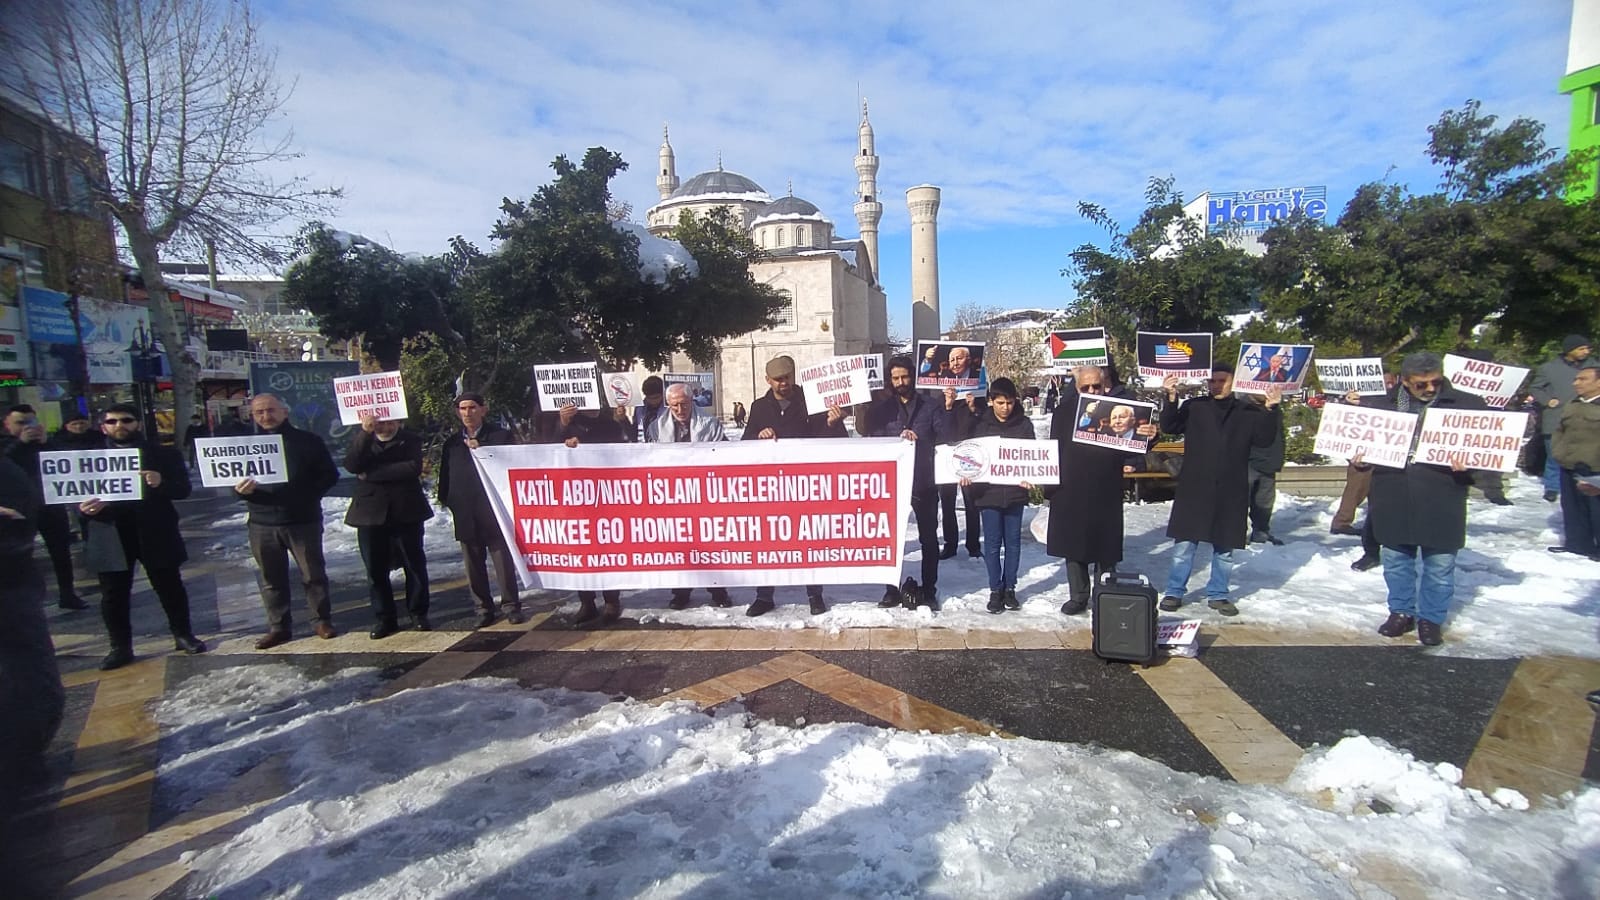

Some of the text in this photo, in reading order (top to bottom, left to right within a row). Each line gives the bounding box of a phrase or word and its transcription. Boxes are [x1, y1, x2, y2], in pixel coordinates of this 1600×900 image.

[1242, 188, 1284, 199] Yeni
[536, 365, 595, 381] KUR'AN-I KERİM'E
[801, 357, 863, 382] HAMAS'A SELAM
[1140, 368, 1164, 377] DOWN
[1317, 363, 1382, 377] MESCİDİ AKSA
[1464, 361, 1504, 377] NATO
[336, 380, 369, 394] KUR'AN-I
[370, 375, 403, 390] KERİM'E
[543, 382, 593, 395] UZANAN ELLER
[1451, 371, 1504, 392] ÜSLERİ
[344, 391, 399, 408] UZANAN ELLER
[824, 392, 851, 408] DEVAM
[1485, 395, 1509, 406] SIN
[1442, 412, 1506, 431] KÜRECİK
[1322, 424, 1408, 446] AKSA'YA
[1422, 430, 1520, 451] NATO RADARI
[203, 444, 278, 457] KAHROLSUN
[998, 446, 1050, 460] İNCİRLİK
[1427, 446, 1504, 469] SÖKÜLSÜN
[42, 455, 139, 474] GO HOME
[211, 457, 277, 478] İSRAİL
[990, 464, 1059, 477] KAPATILSIN
[52, 478, 132, 496] YANKEE
[516, 470, 890, 507] KATİL ABD/NATO İSLAM ÜLKELERİNDEN DEFOL
[520, 508, 891, 544] YANKEE GO HOME! DEATH TO AMERİCA
[527, 545, 891, 568] KÜRECİK NATO RADAR ÜSSÜNE HAYIR İNİSİYATİFİ
